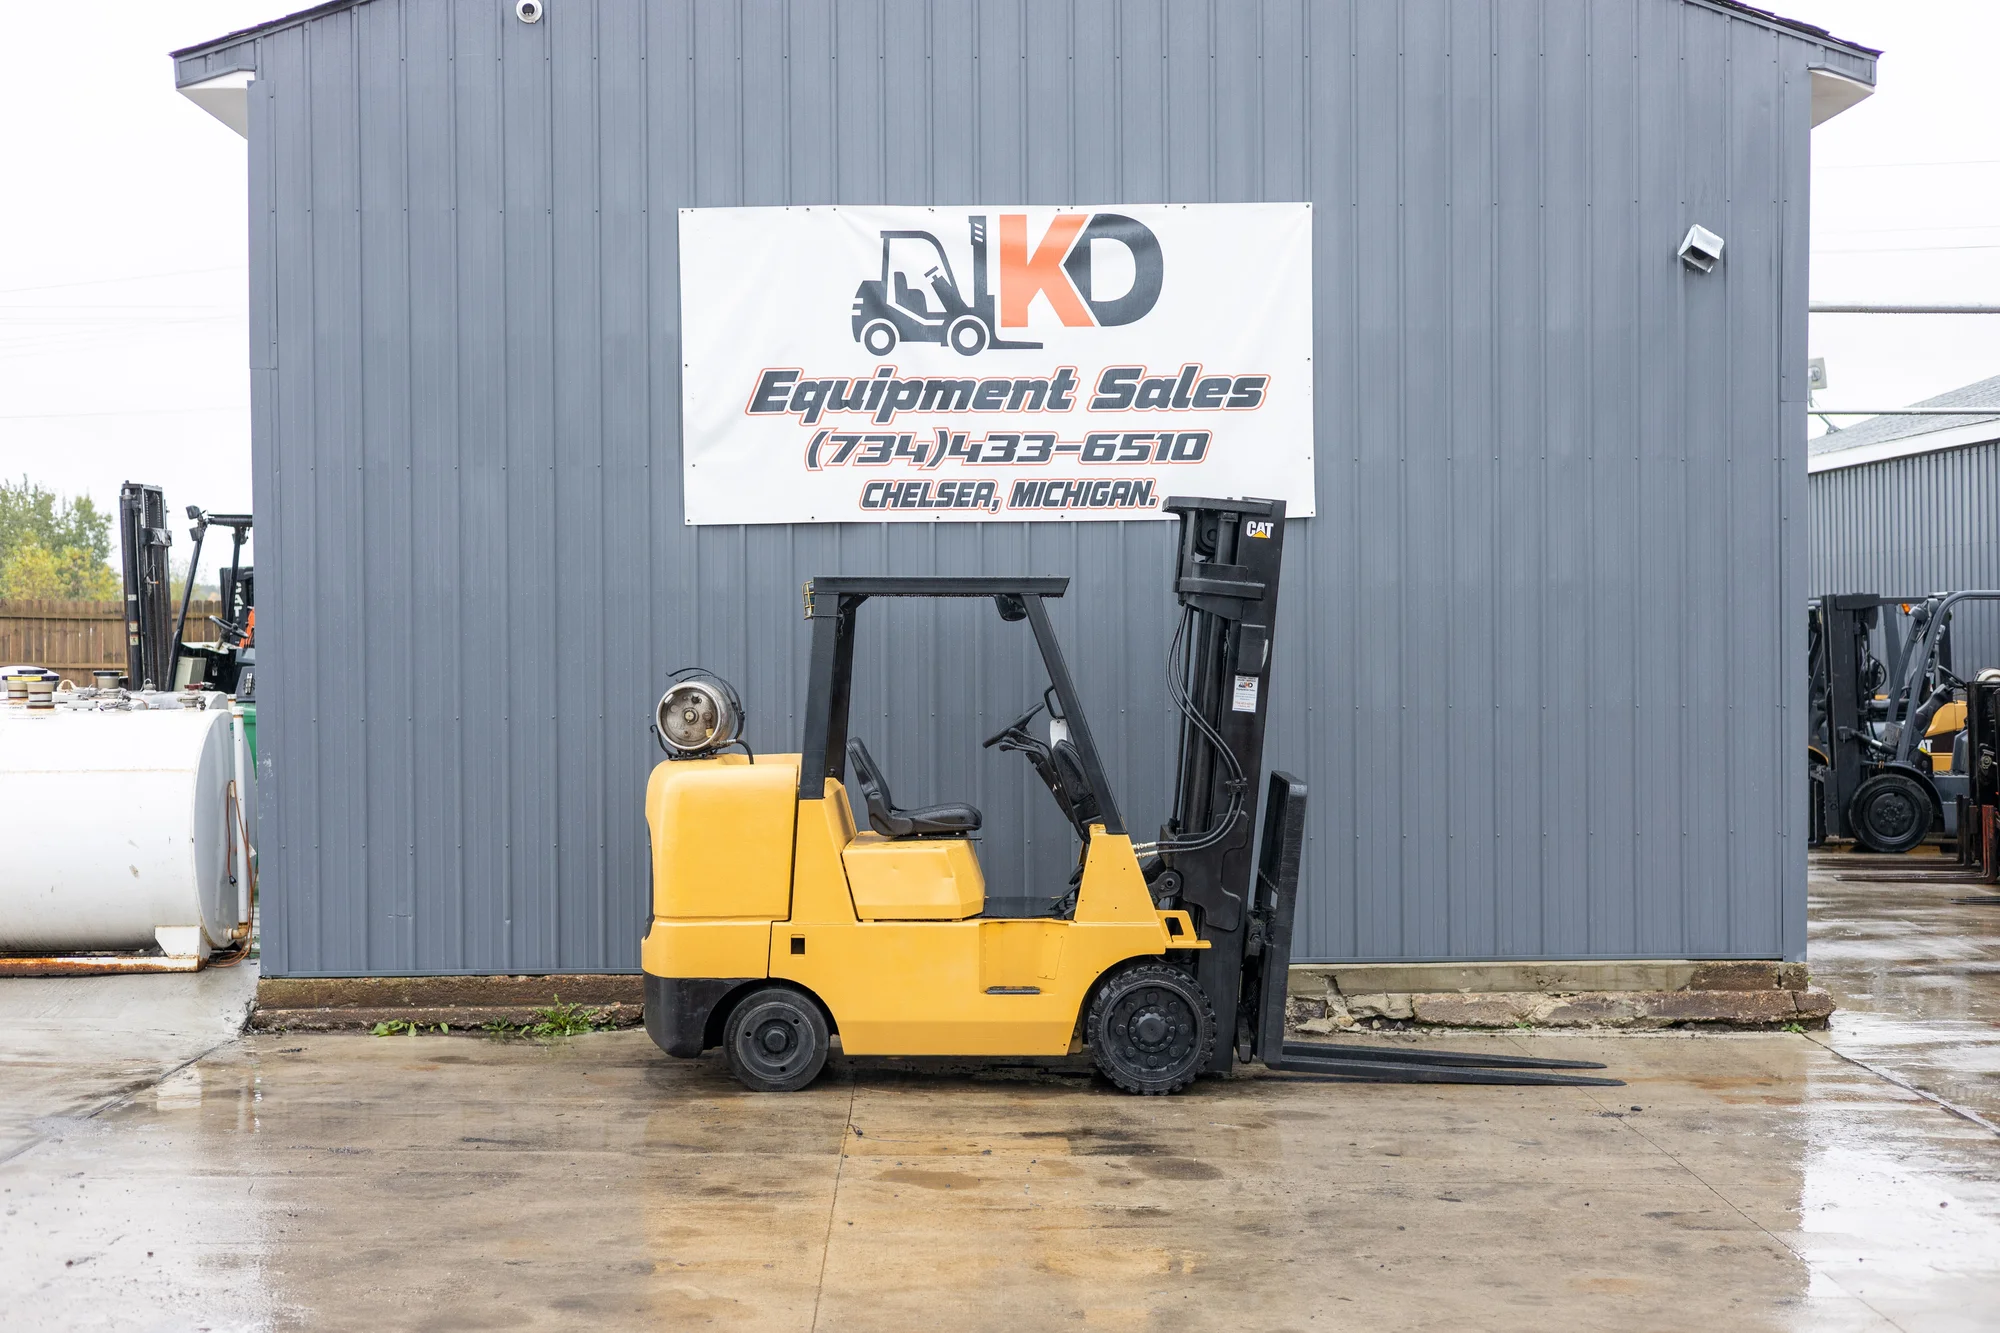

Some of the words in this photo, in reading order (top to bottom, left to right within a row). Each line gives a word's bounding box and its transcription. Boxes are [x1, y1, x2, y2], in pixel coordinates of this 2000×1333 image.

[999, 213, 1164, 327] KD
[747, 367, 1077, 424] Equipment
[1089, 364, 1267, 411] Sales
[806, 429, 1211, 468] (734)433-6510
[862, 481, 999, 512] CHELSEA,
[1009, 480, 1157, 508] MICHIGAN.
[1246, 521, 1274, 539] CAT
[1917, 739, 1933, 753] AT
